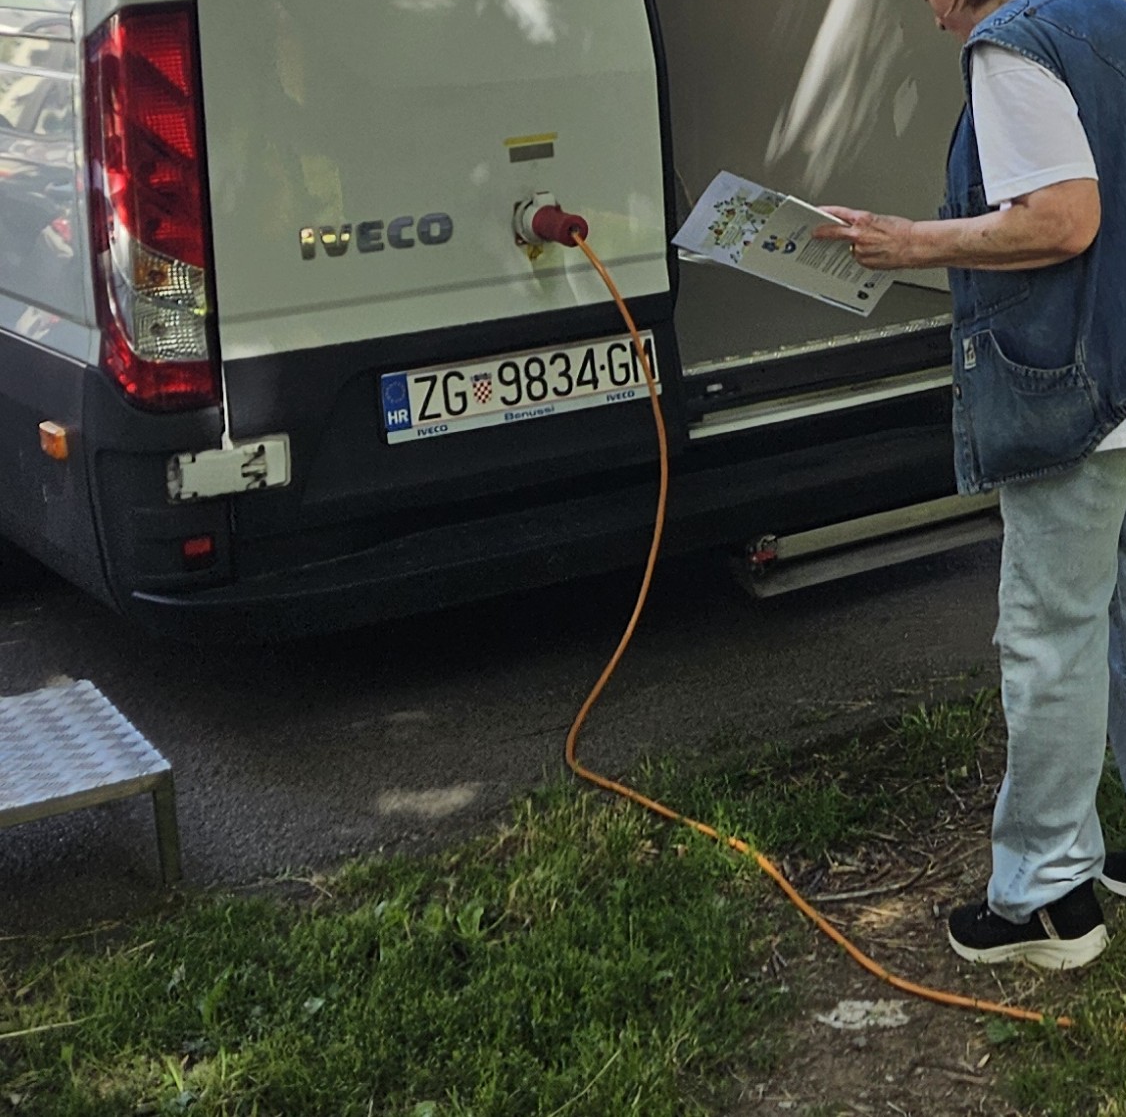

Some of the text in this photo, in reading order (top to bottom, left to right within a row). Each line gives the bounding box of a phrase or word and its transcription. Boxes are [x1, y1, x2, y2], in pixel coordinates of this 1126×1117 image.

[299, 212, 454, 261] IVECO
[413, 370, 468, 422] ZG
[605, 389, 635, 403] IVECO
[387, 408, 409, 425] HR
[504, 405, 555, 421] Benussi
[417, 424, 448, 436] IVECO
